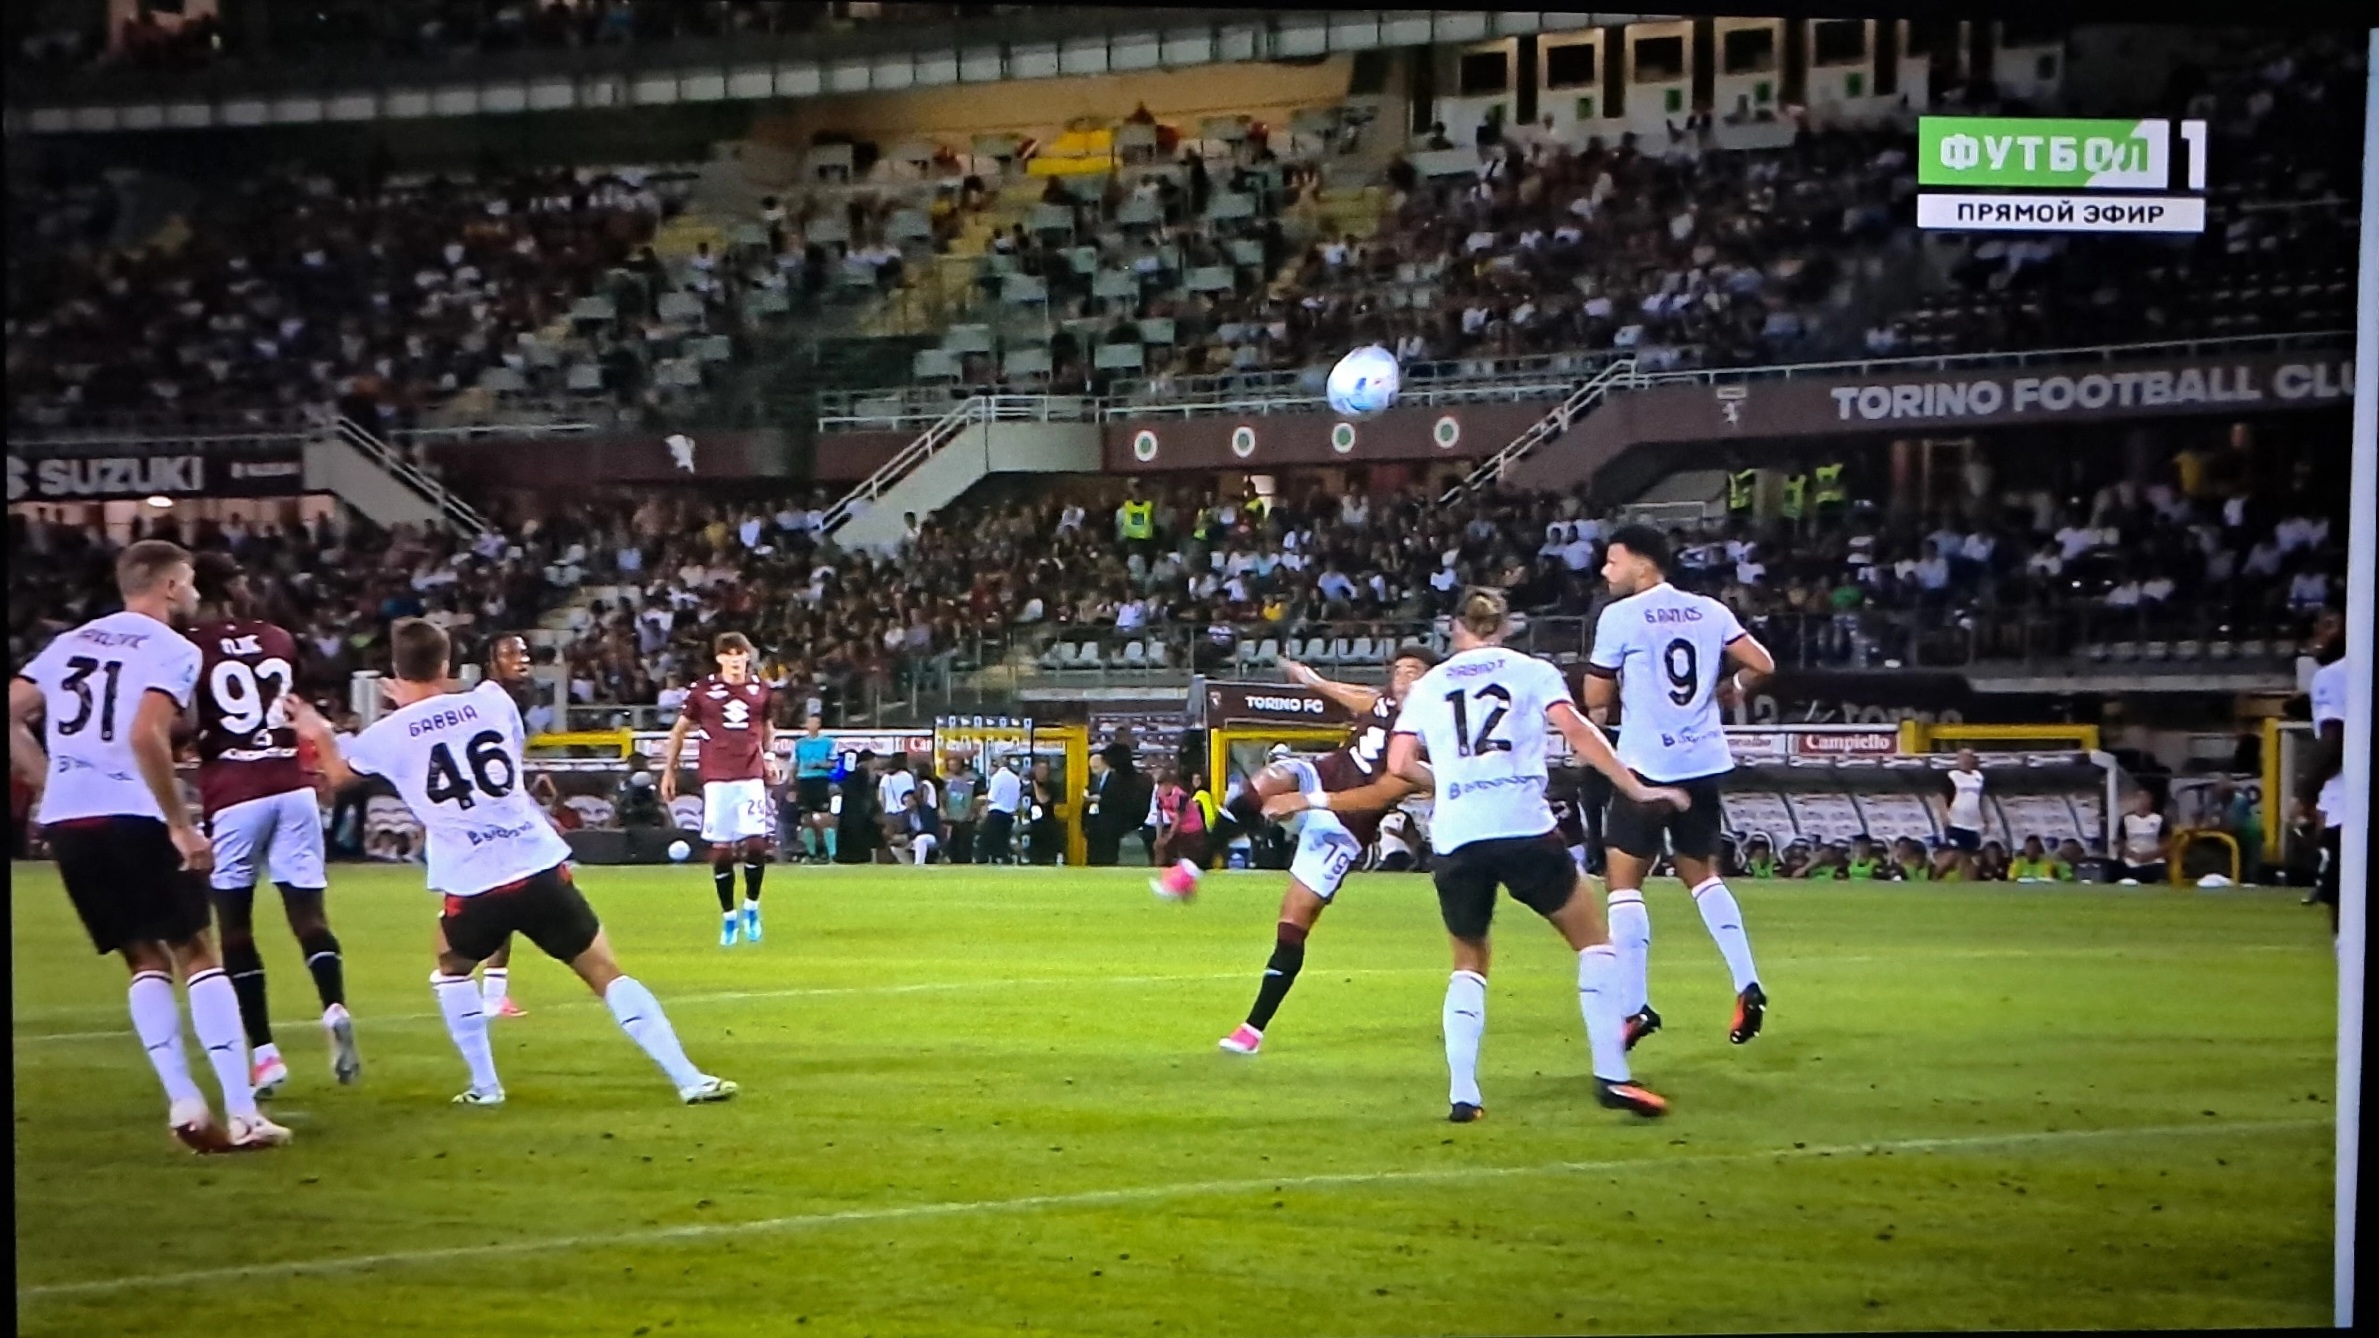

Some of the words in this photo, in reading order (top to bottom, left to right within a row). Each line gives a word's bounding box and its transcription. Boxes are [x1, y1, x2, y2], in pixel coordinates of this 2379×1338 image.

[1940, 133, 2149, 172] ФУТБОЛ
[2181, 119, 2206, 188] 1
[1957, 201, 2074, 222] ПРЯМОЙ
[2083, 205, 2165, 224] ЭФИР
[1830, 380, 2002, 420] TORINO
[2013, 364, 2263, 412] FOOTBALL
[38, 457, 204, 495] SUZUKI
[57, 655, 123, 742] 31
[210, 657, 293, 734] 92
[1664, 637, 1698, 706] 9
[409, 704, 479, 737] GABBIA
[1245, 695, 1302, 712] TORINO
[1445, 683, 1512, 757] 12
[426, 729, 515, 811] 46
[1806, 733, 1891, 753] Campiello
